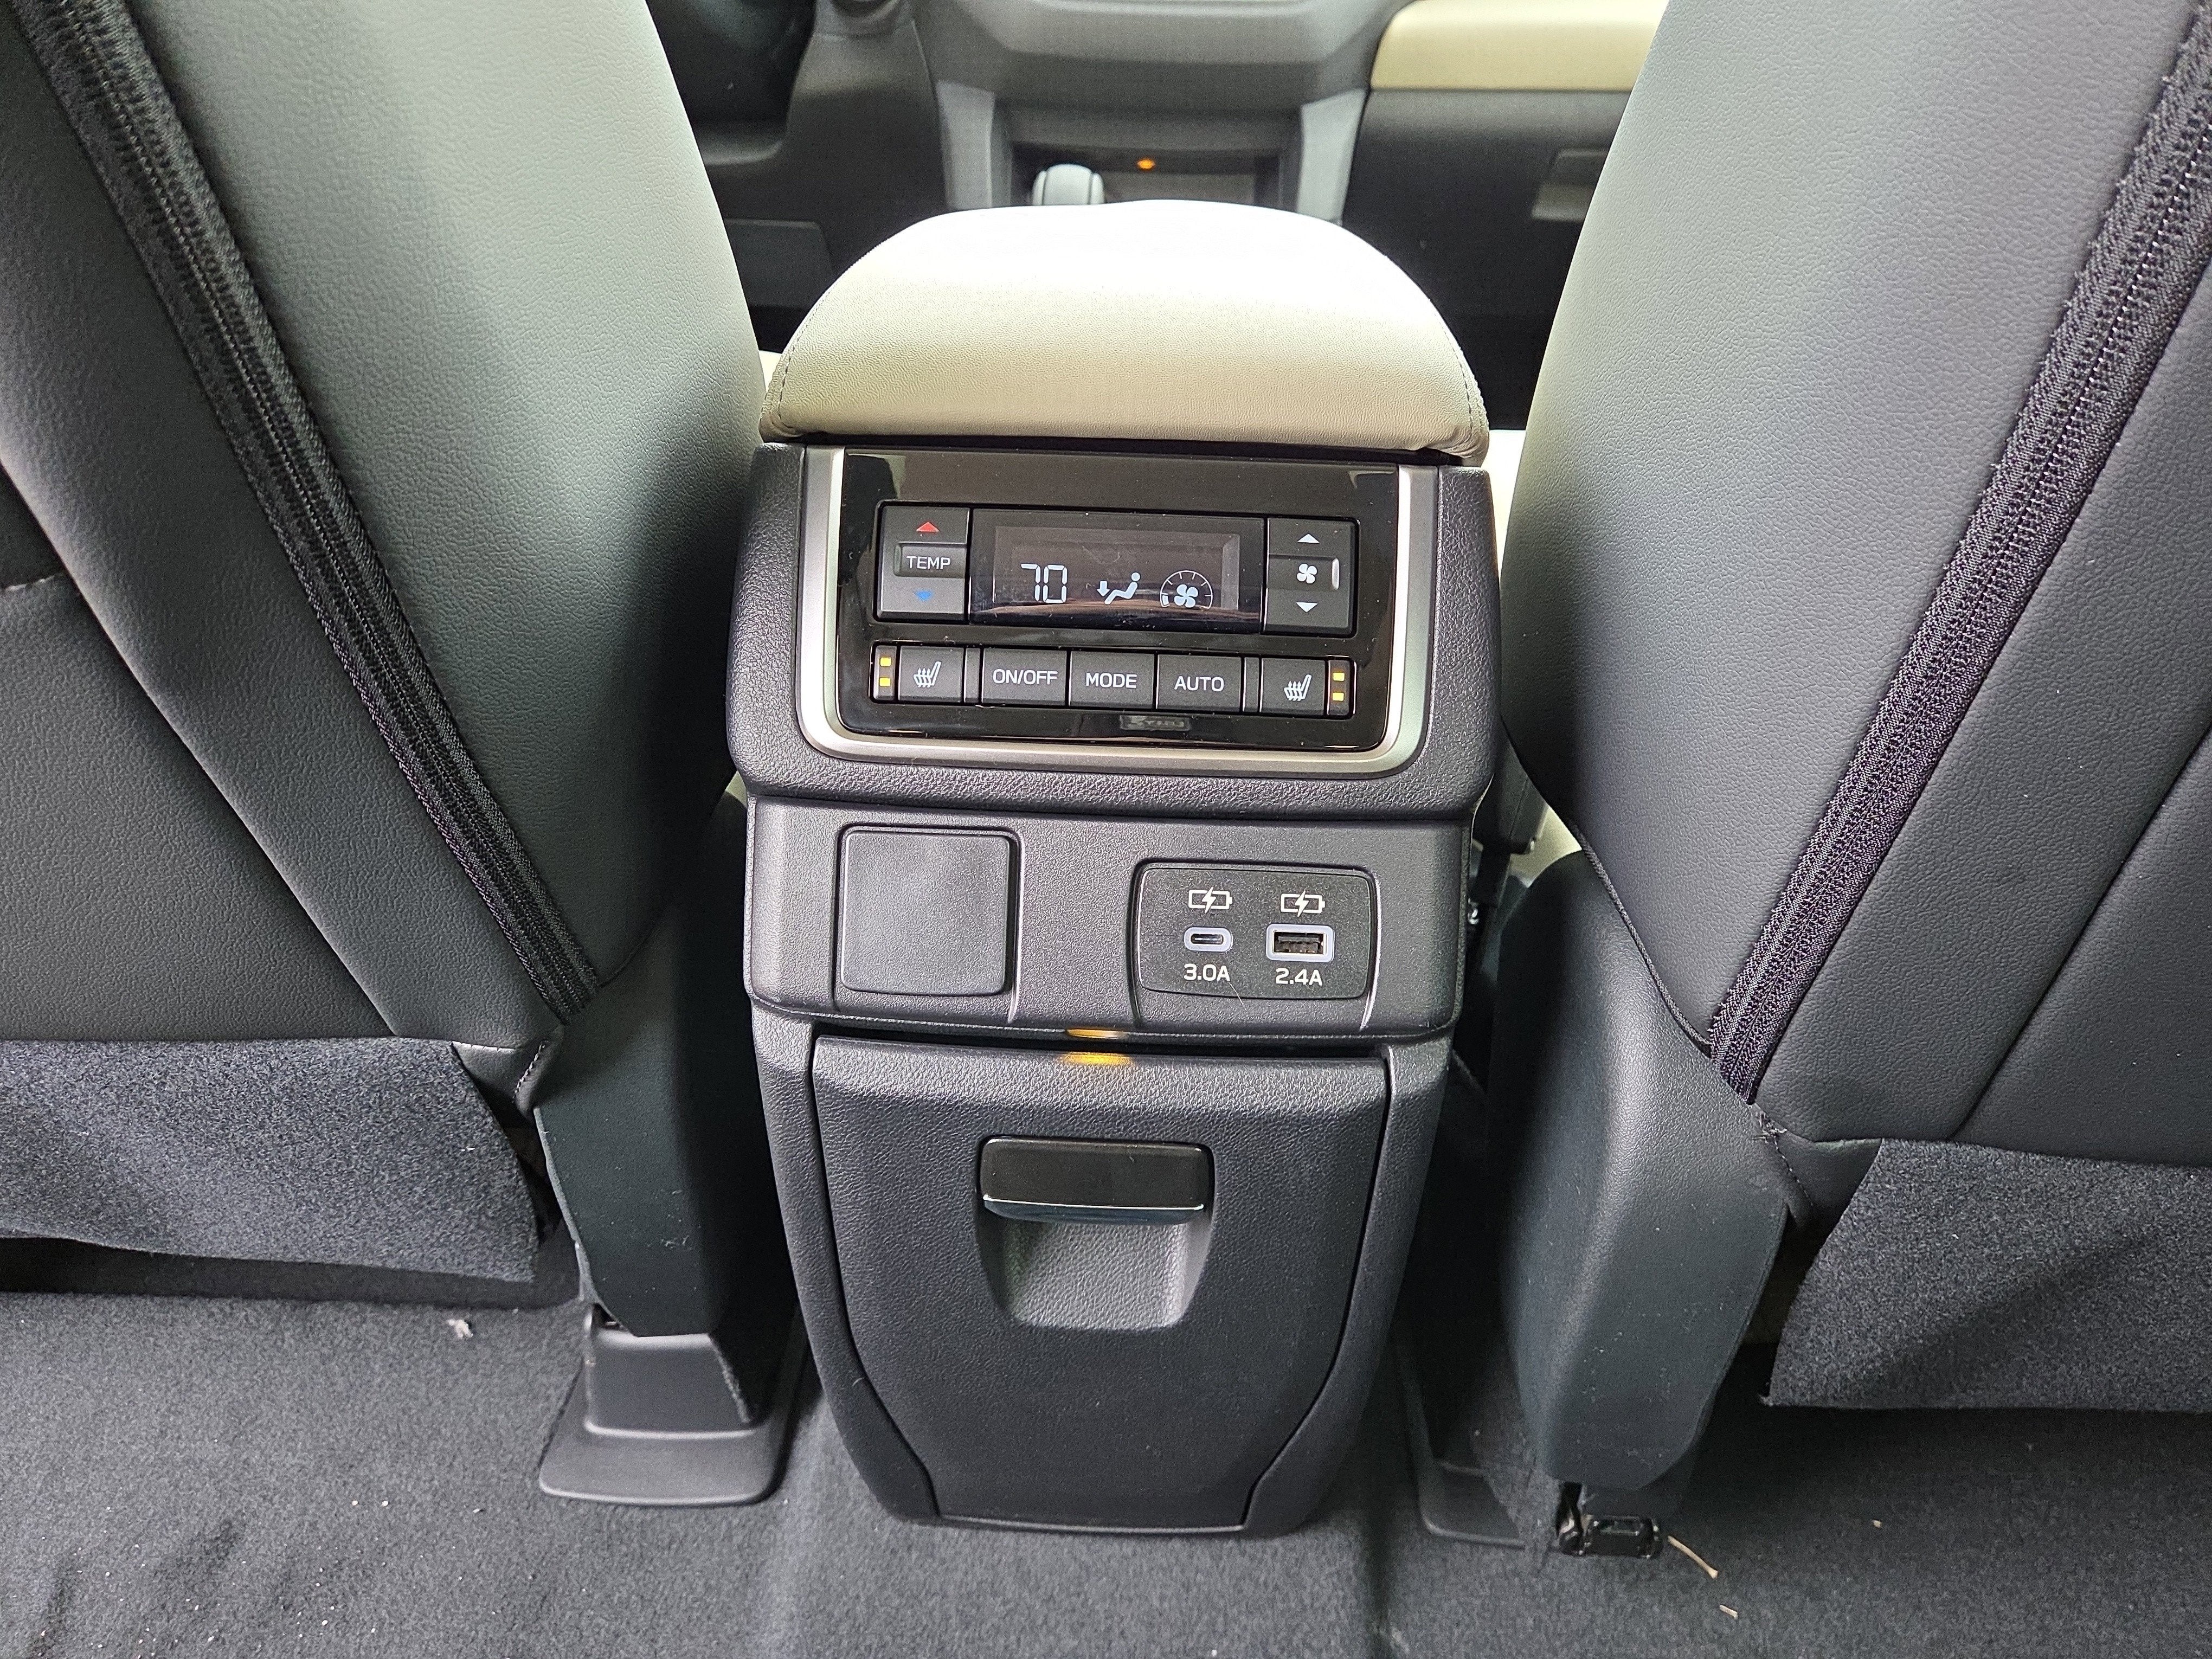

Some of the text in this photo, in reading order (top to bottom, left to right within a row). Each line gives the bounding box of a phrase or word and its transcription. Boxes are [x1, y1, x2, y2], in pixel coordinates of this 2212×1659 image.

[906, 555, 951, 570] TEMP
[1020, 563, 1068, 604] 70
[992, 668, 1058, 685] ON/OFF
[1085, 672, 1137, 689] MODE
[1174, 676, 1224, 692] AUTO
[1183, 963, 1230, 981] 3.0A
[1275, 968, 1323, 986] 2.4A
